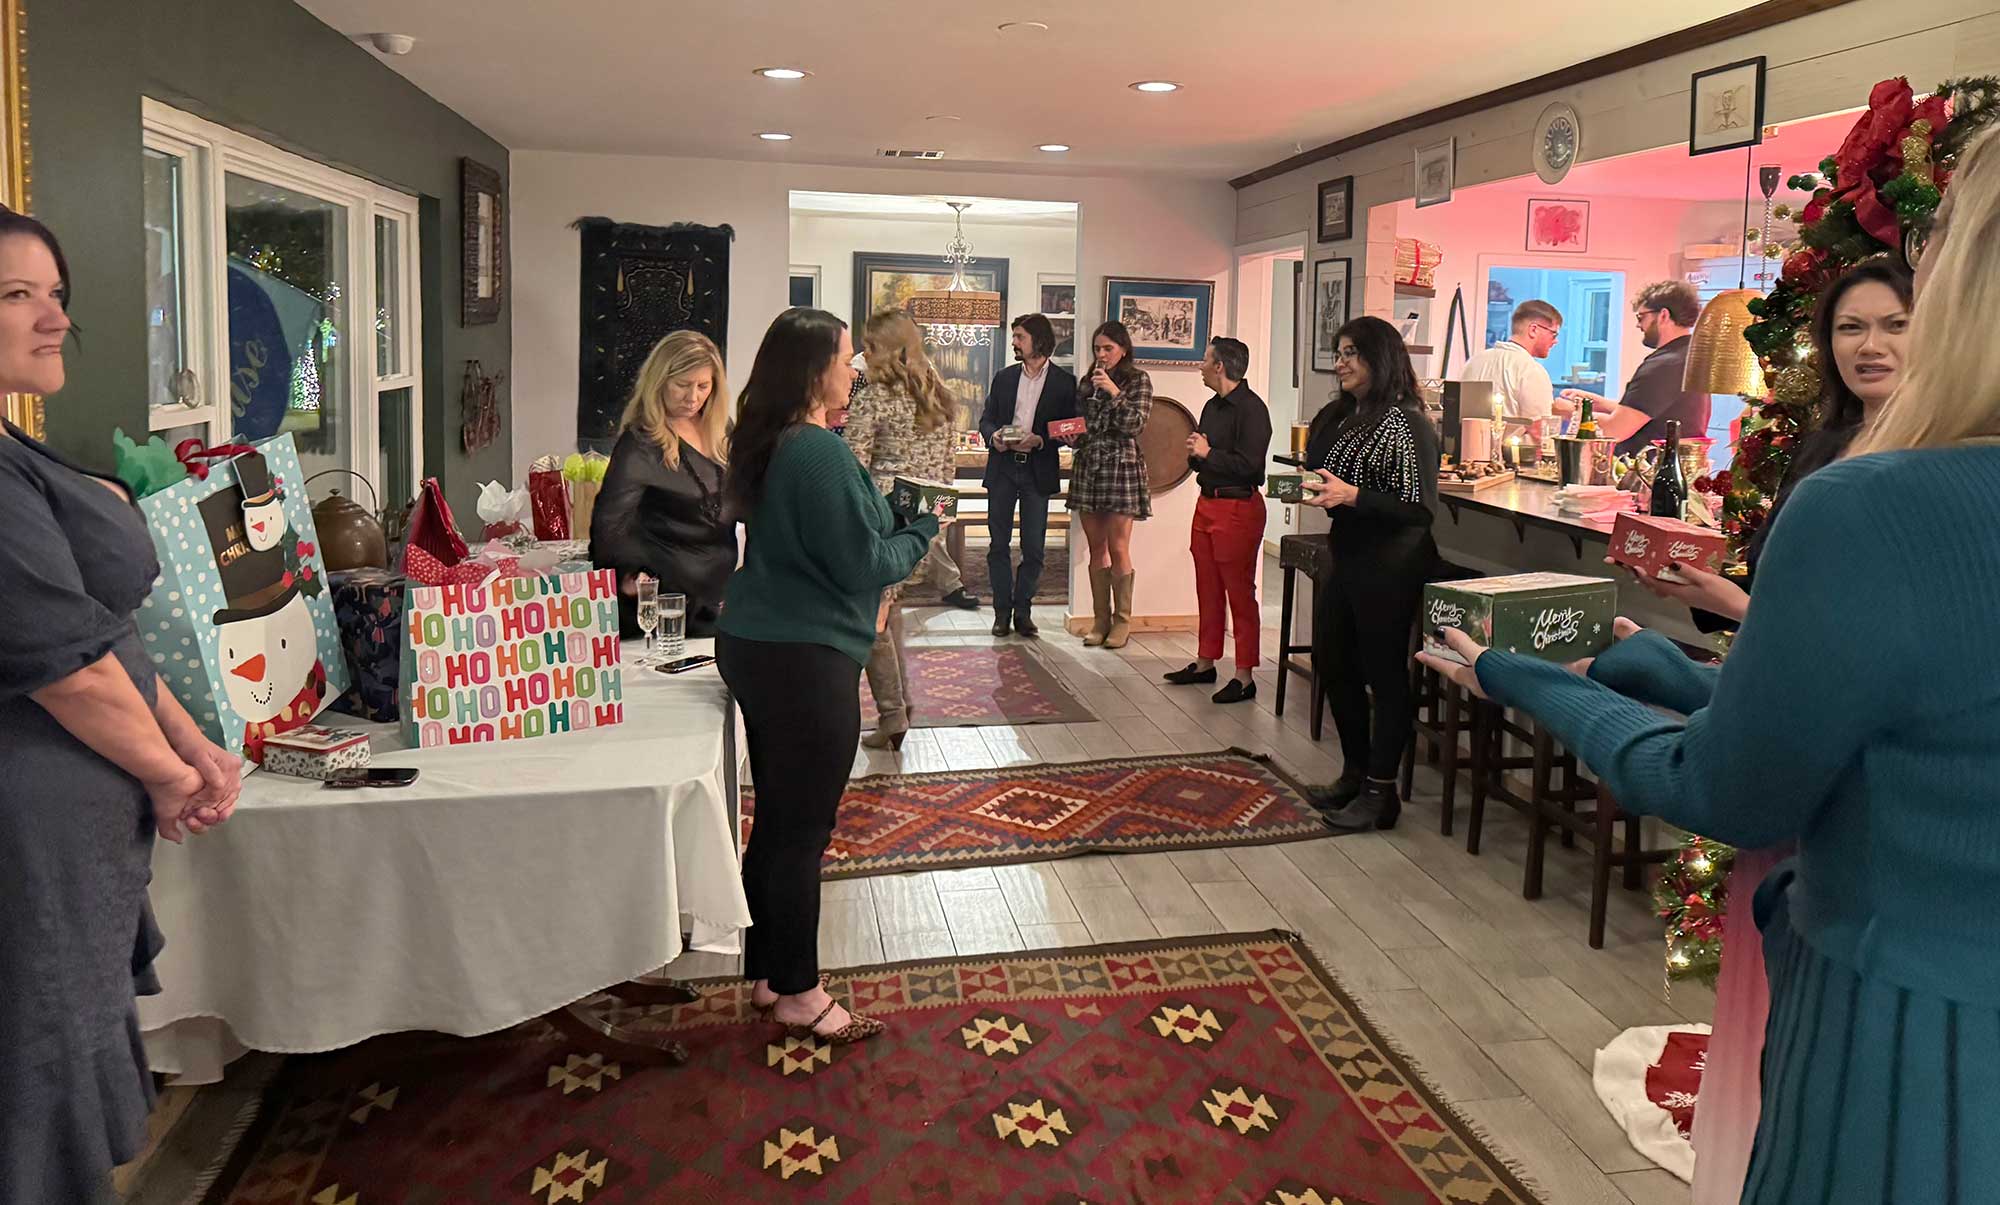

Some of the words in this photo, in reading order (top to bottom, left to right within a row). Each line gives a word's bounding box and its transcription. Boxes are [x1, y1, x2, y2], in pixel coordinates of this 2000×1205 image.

[452, 614, 497, 651] HO
[501, 602, 545, 641] HO
[547, 596, 592, 629] HO
[1530, 606, 1584, 638] Merry
[446, 651, 491, 689] HO
[496, 639, 541, 677] HO
[544, 631, 587, 665] HO
[455, 685, 500, 725] HO
[505, 672, 550, 713] HO
[553, 666, 596, 699] HO
[549, 700, 591, 734] HO
